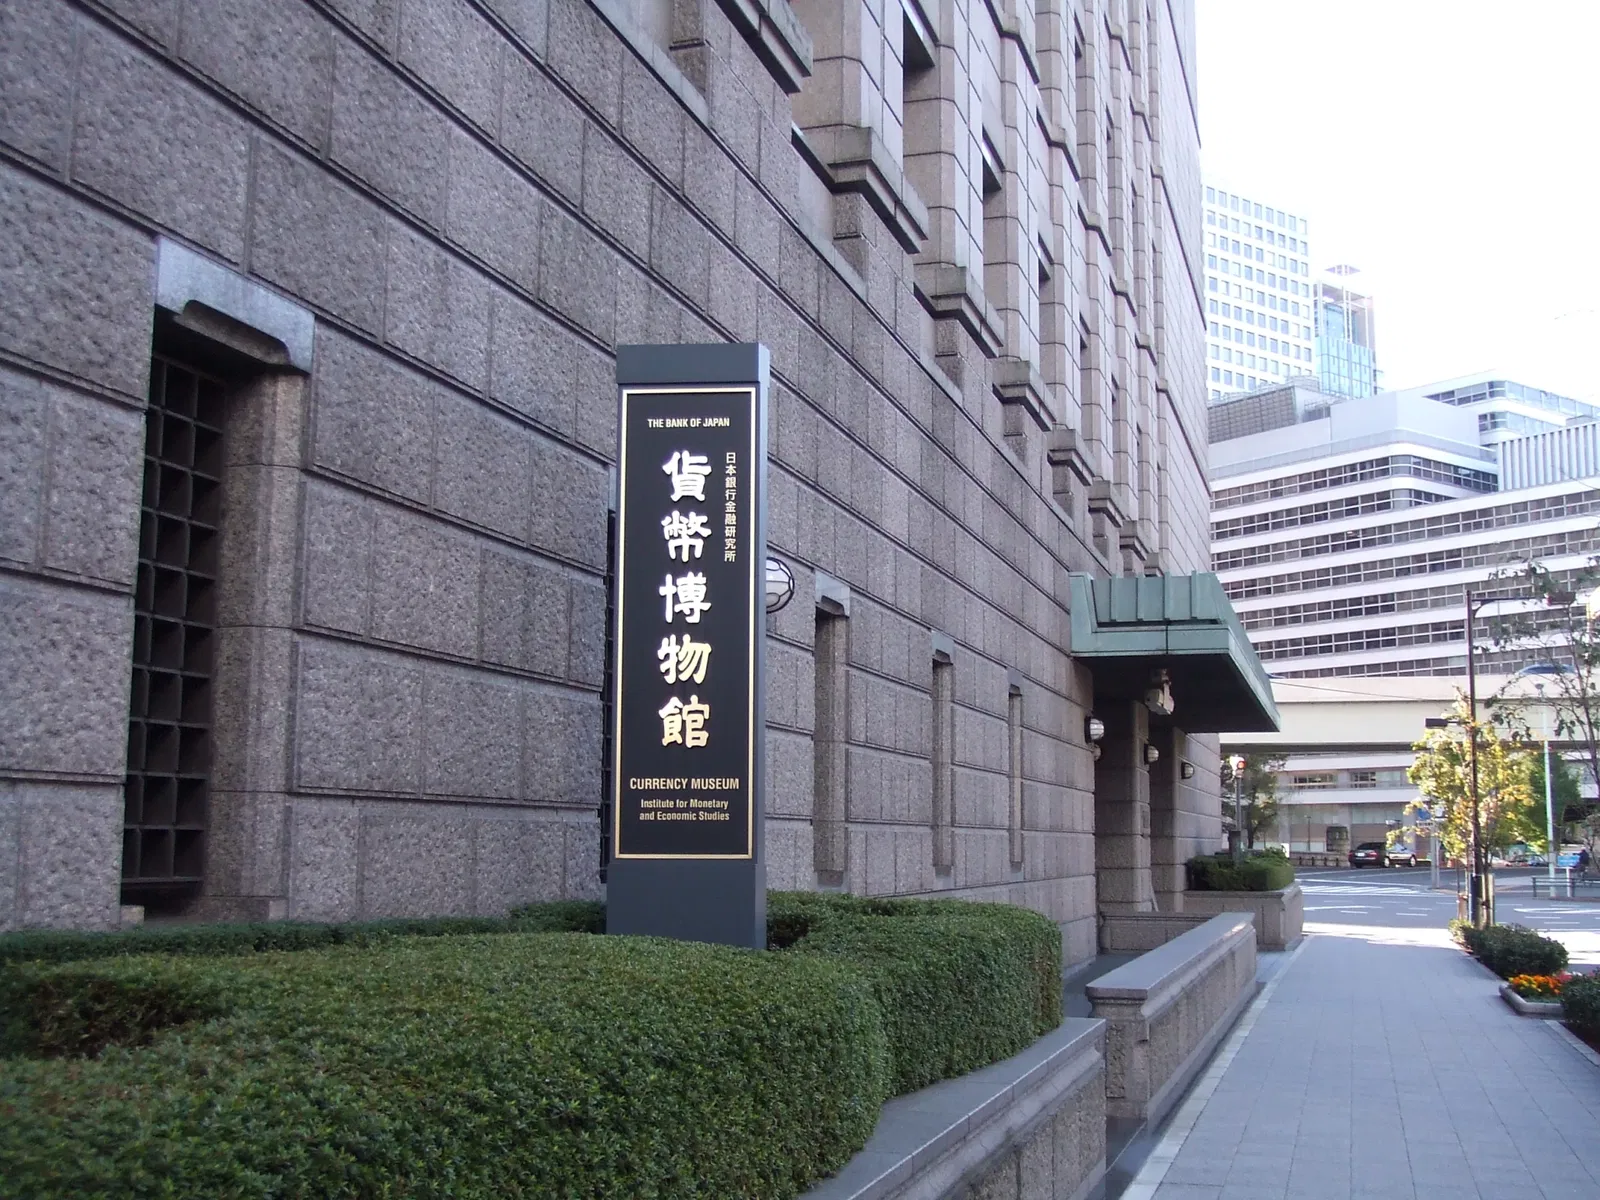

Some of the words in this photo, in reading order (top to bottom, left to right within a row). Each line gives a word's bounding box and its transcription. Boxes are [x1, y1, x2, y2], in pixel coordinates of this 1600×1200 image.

[647, 418, 664, 428] THE
[666, 418, 689, 428] BANK
[690, 418, 701, 428] OF
[702, 417, 730, 427] JAPAN
[724, 452, 737, 563] 日本銀行金融研究所
[657, 449, 712, 748] 貨幣博物館
[629, 777, 689, 790] CURRENCY
[690, 777, 740, 790] MUSEUM
[640, 799, 674, 809] Institute
[676, 799, 688, 809] for
[690, 799, 729, 810] Monetary
[639, 811, 655, 821] and
[656, 811, 697, 821] Economic
[698, 811, 730, 821] Studies
